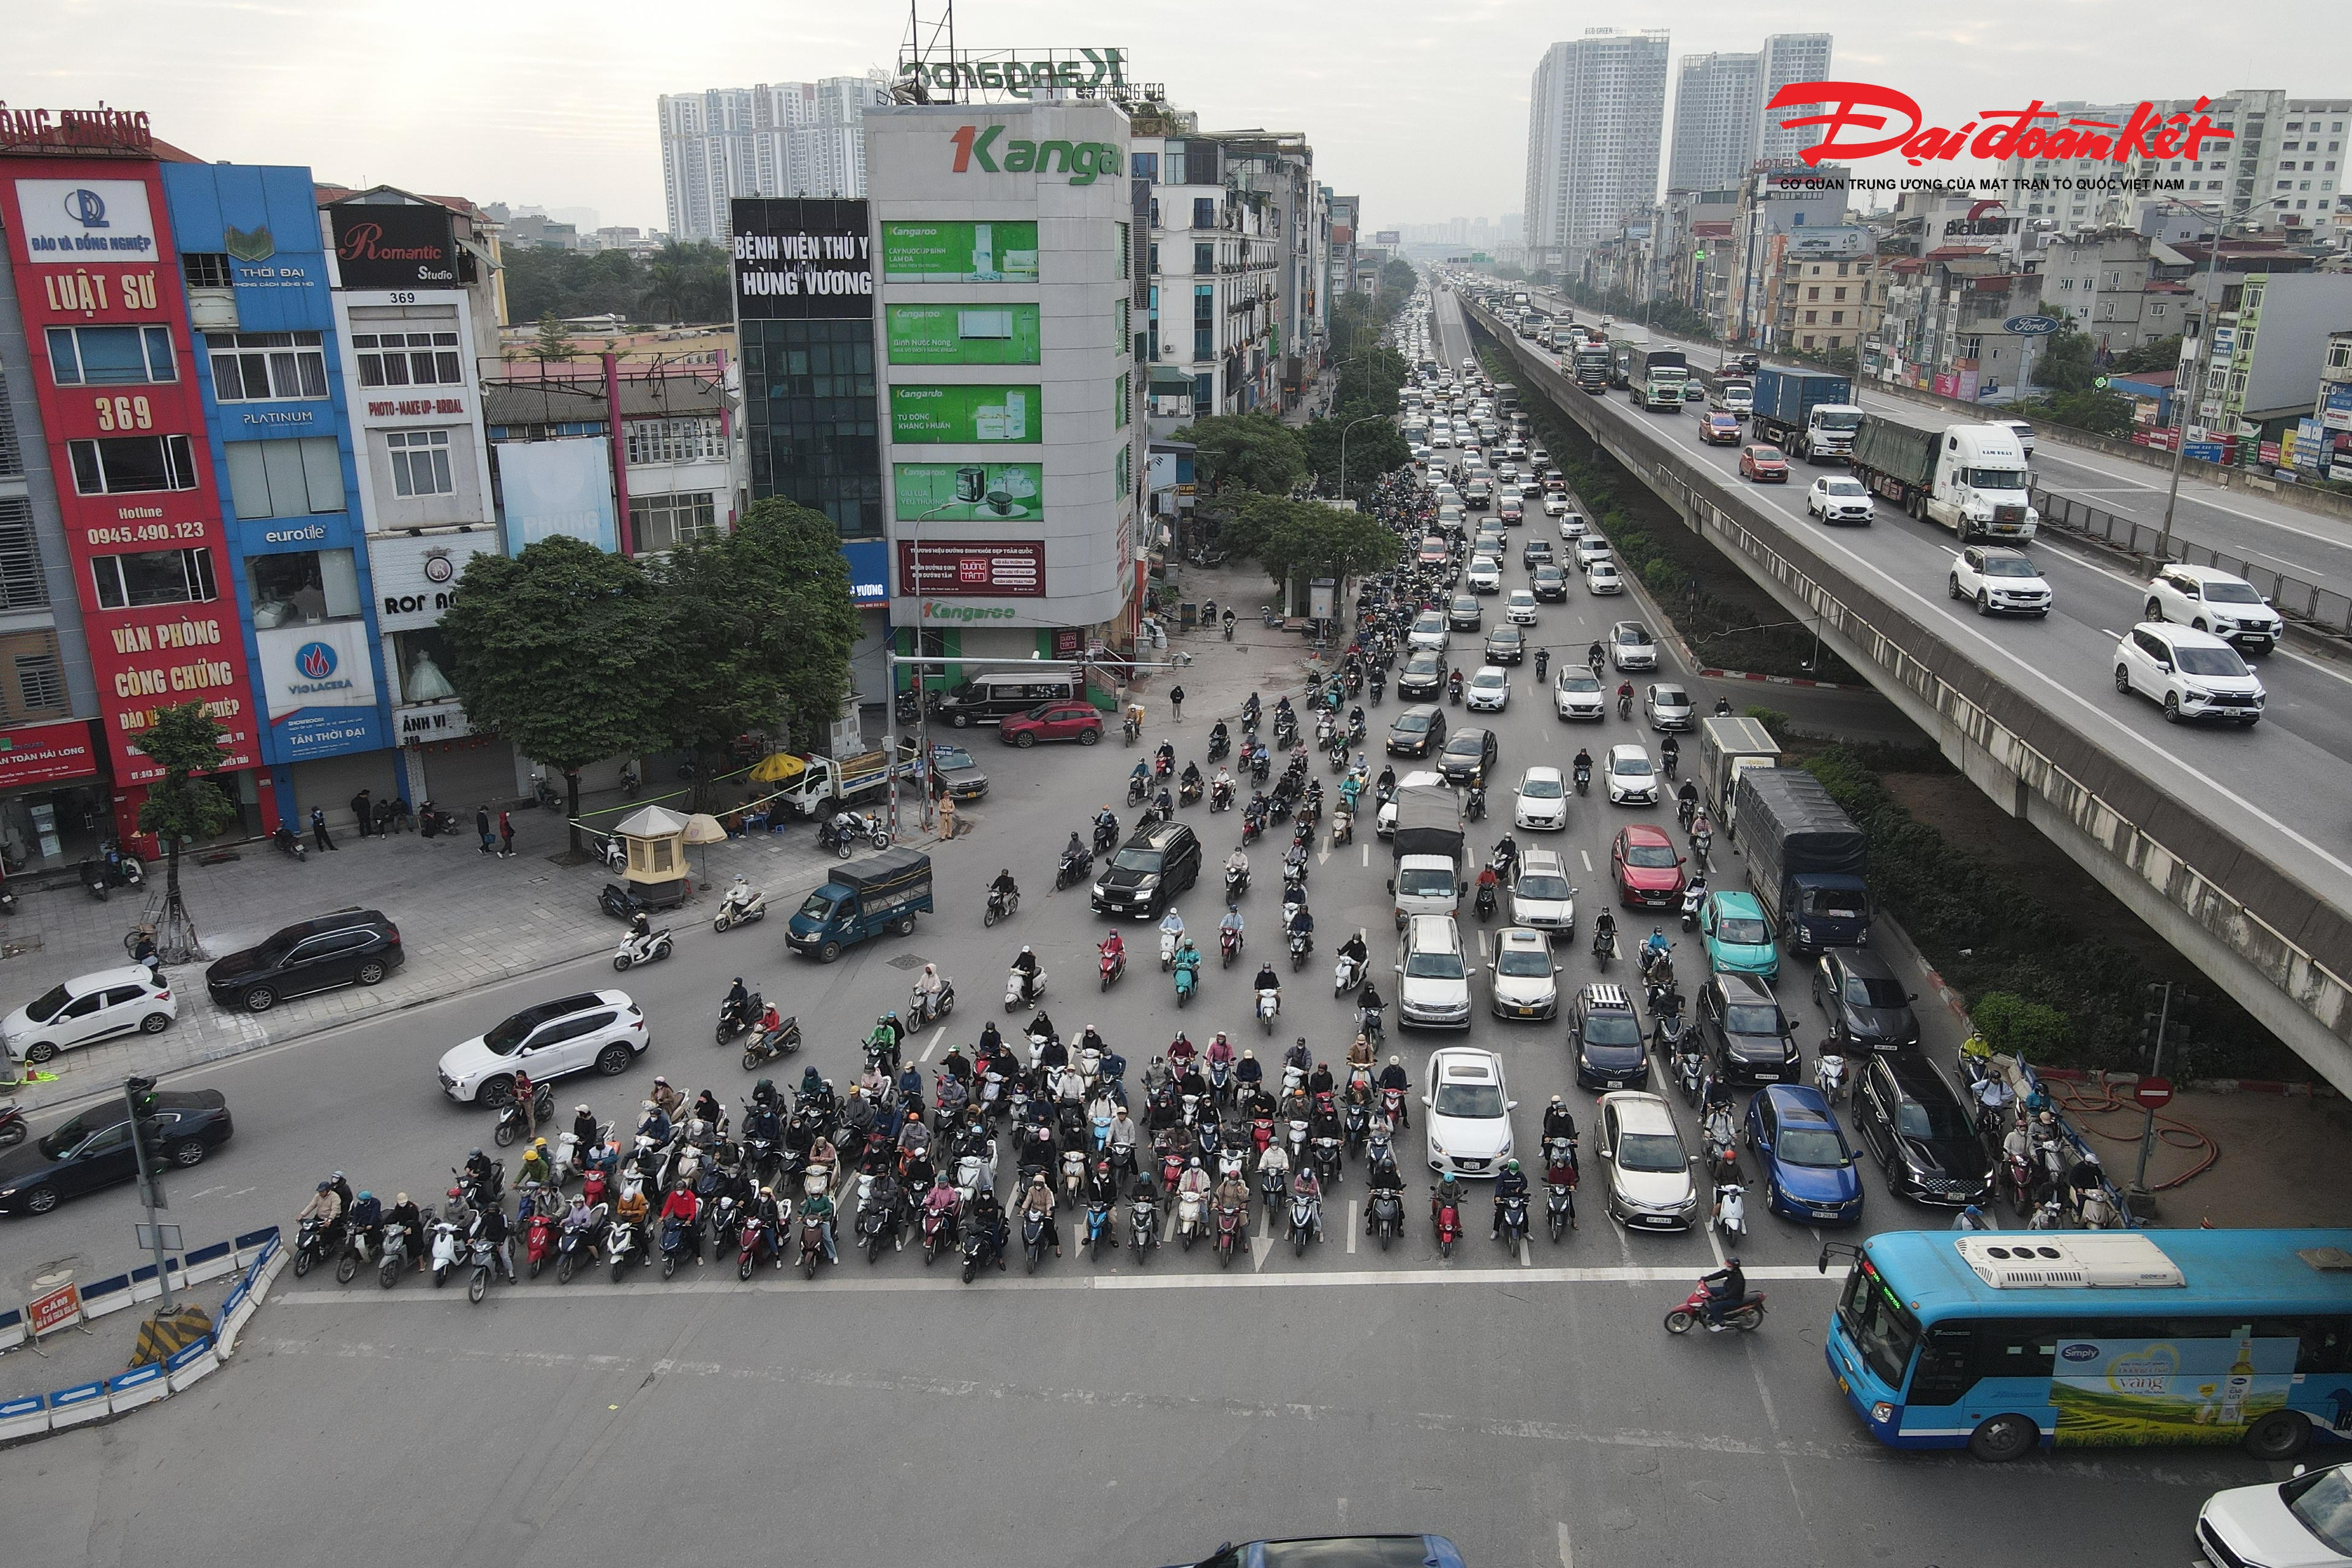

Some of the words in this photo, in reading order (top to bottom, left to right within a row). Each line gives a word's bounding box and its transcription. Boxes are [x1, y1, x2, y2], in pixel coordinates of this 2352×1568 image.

[61, 100, 153, 148] CHỨNG
[58, 235, 74, 251] VÀ
[75, 232, 109, 251] ĐỒNG
[110, 235, 151, 252] NGHIỆP
[337, 222, 442, 260] Romantic
[734, 230, 778, 265] BỆNH
[782, 231, 820, 265] VIỆN
[823, 230, 854, 260] THÚ
[859, 236, 869, 260] Y
[418, 266, 453, 281] Studio
[742, 266, 799, 295] HÙNG
[804, 269, 872, 295] VƯƠNG
[45, 268, 109, 317] LUẬT
[123, 270, 158, 310] SƯ
[390, 292, 415, 304] 369
[2015, 317, 2049, 332] Ford
[96, 396, 153, 431] 369
[243, 411, 313, 424] PLATINUM
[368, 401, 395, 417] PHOTO
[399, 400, 421, 415] MAKE
[421, 400, 432, 414] UP
[436, 399, 464, 413] BRIDAL
[119, 507, 163, 519] Hotline
[88, 522, 205, 545] 0945.490.123
[266, 524, 325, 543] eurotile
[111, 622, 152, 654] VĂN
[156, 615, 221, 649] PHÒNG
[115, 666, 167, 698] CÔNG
[171, 658, 233, 692] CHỨNG
[119, 707, 145, 730] ĐÀO
[403, 714, 431, 733] ẢNH
[290, 734, 314, 745] TÂN
[315, 729, 342, 742] THỜI
[345, 727, 366, 739] ĐẠI
[10, 752, 38, 763] TOÀN
[40, 748, 56, 759] HẢI
[59, 746, 85, 756] LONG
[2065, 1348, 2098, 1358] Simply
[2120, 1376, 2164, 1390] vàng
